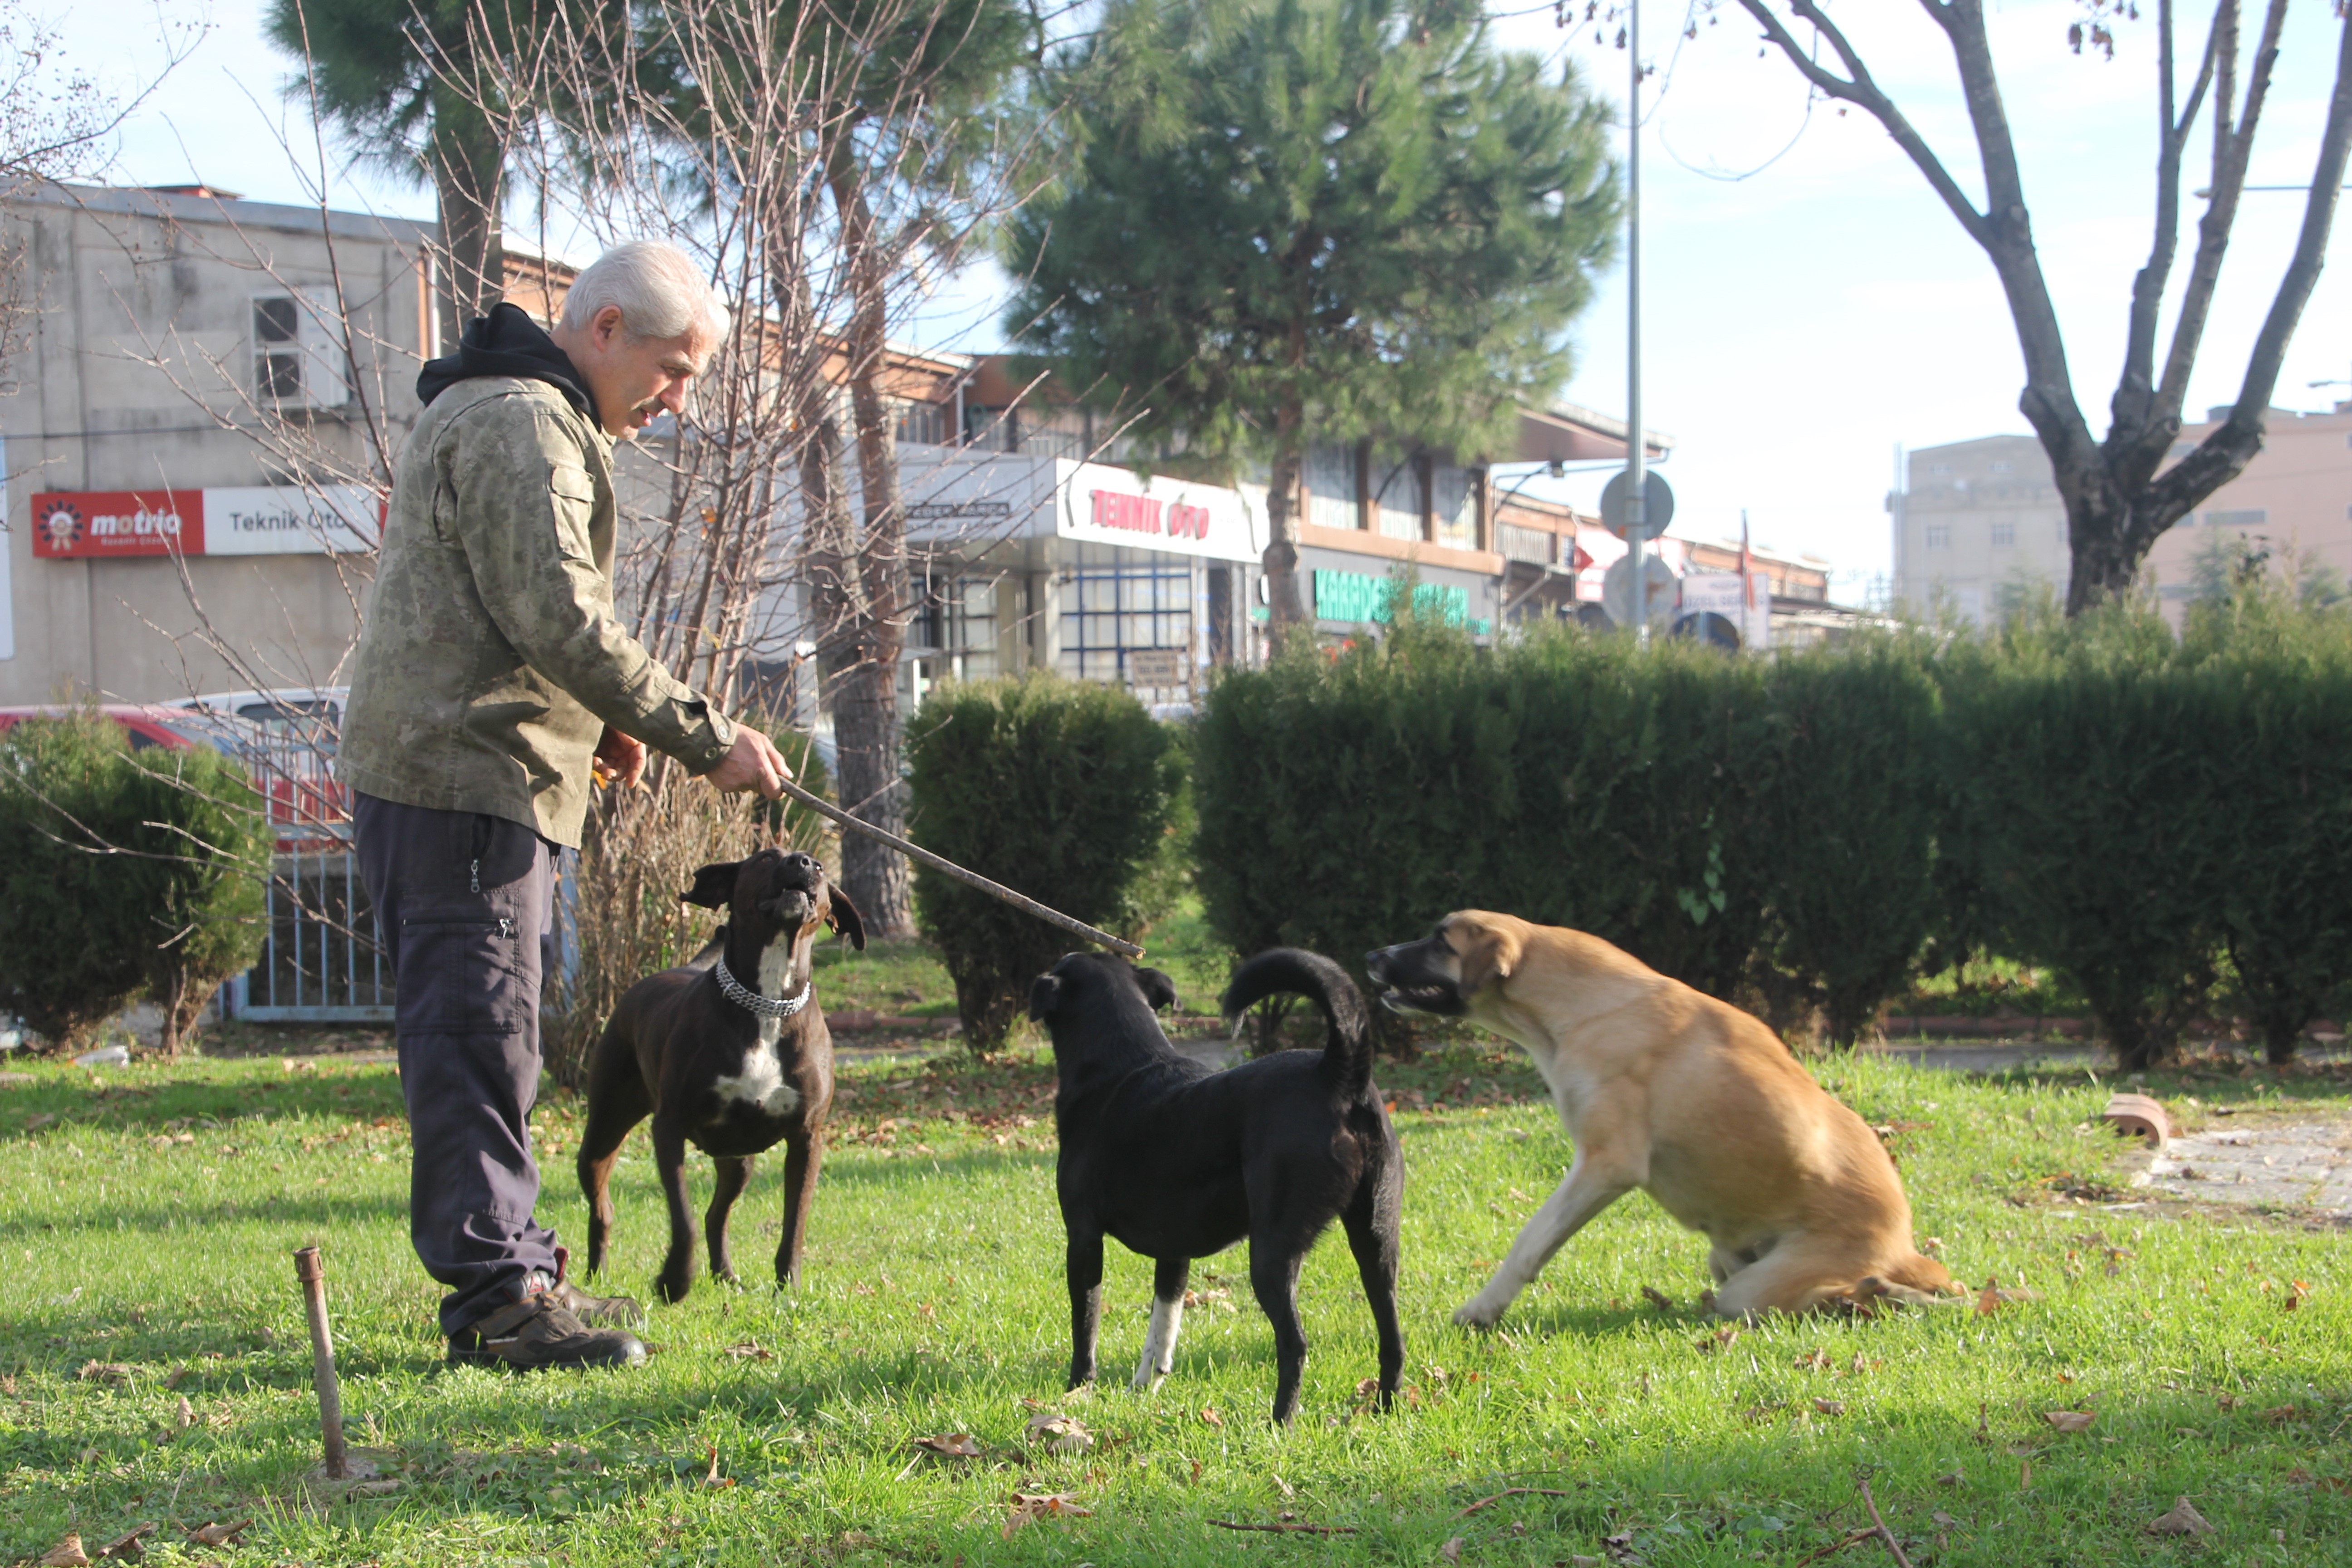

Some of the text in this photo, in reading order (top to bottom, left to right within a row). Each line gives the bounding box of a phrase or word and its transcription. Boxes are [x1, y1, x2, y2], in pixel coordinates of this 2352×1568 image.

[91, 508, 182, 535] motrio
[229, 510, 346, 531] Teknik Oto
[1167, 503, 1209, 540] OTO
